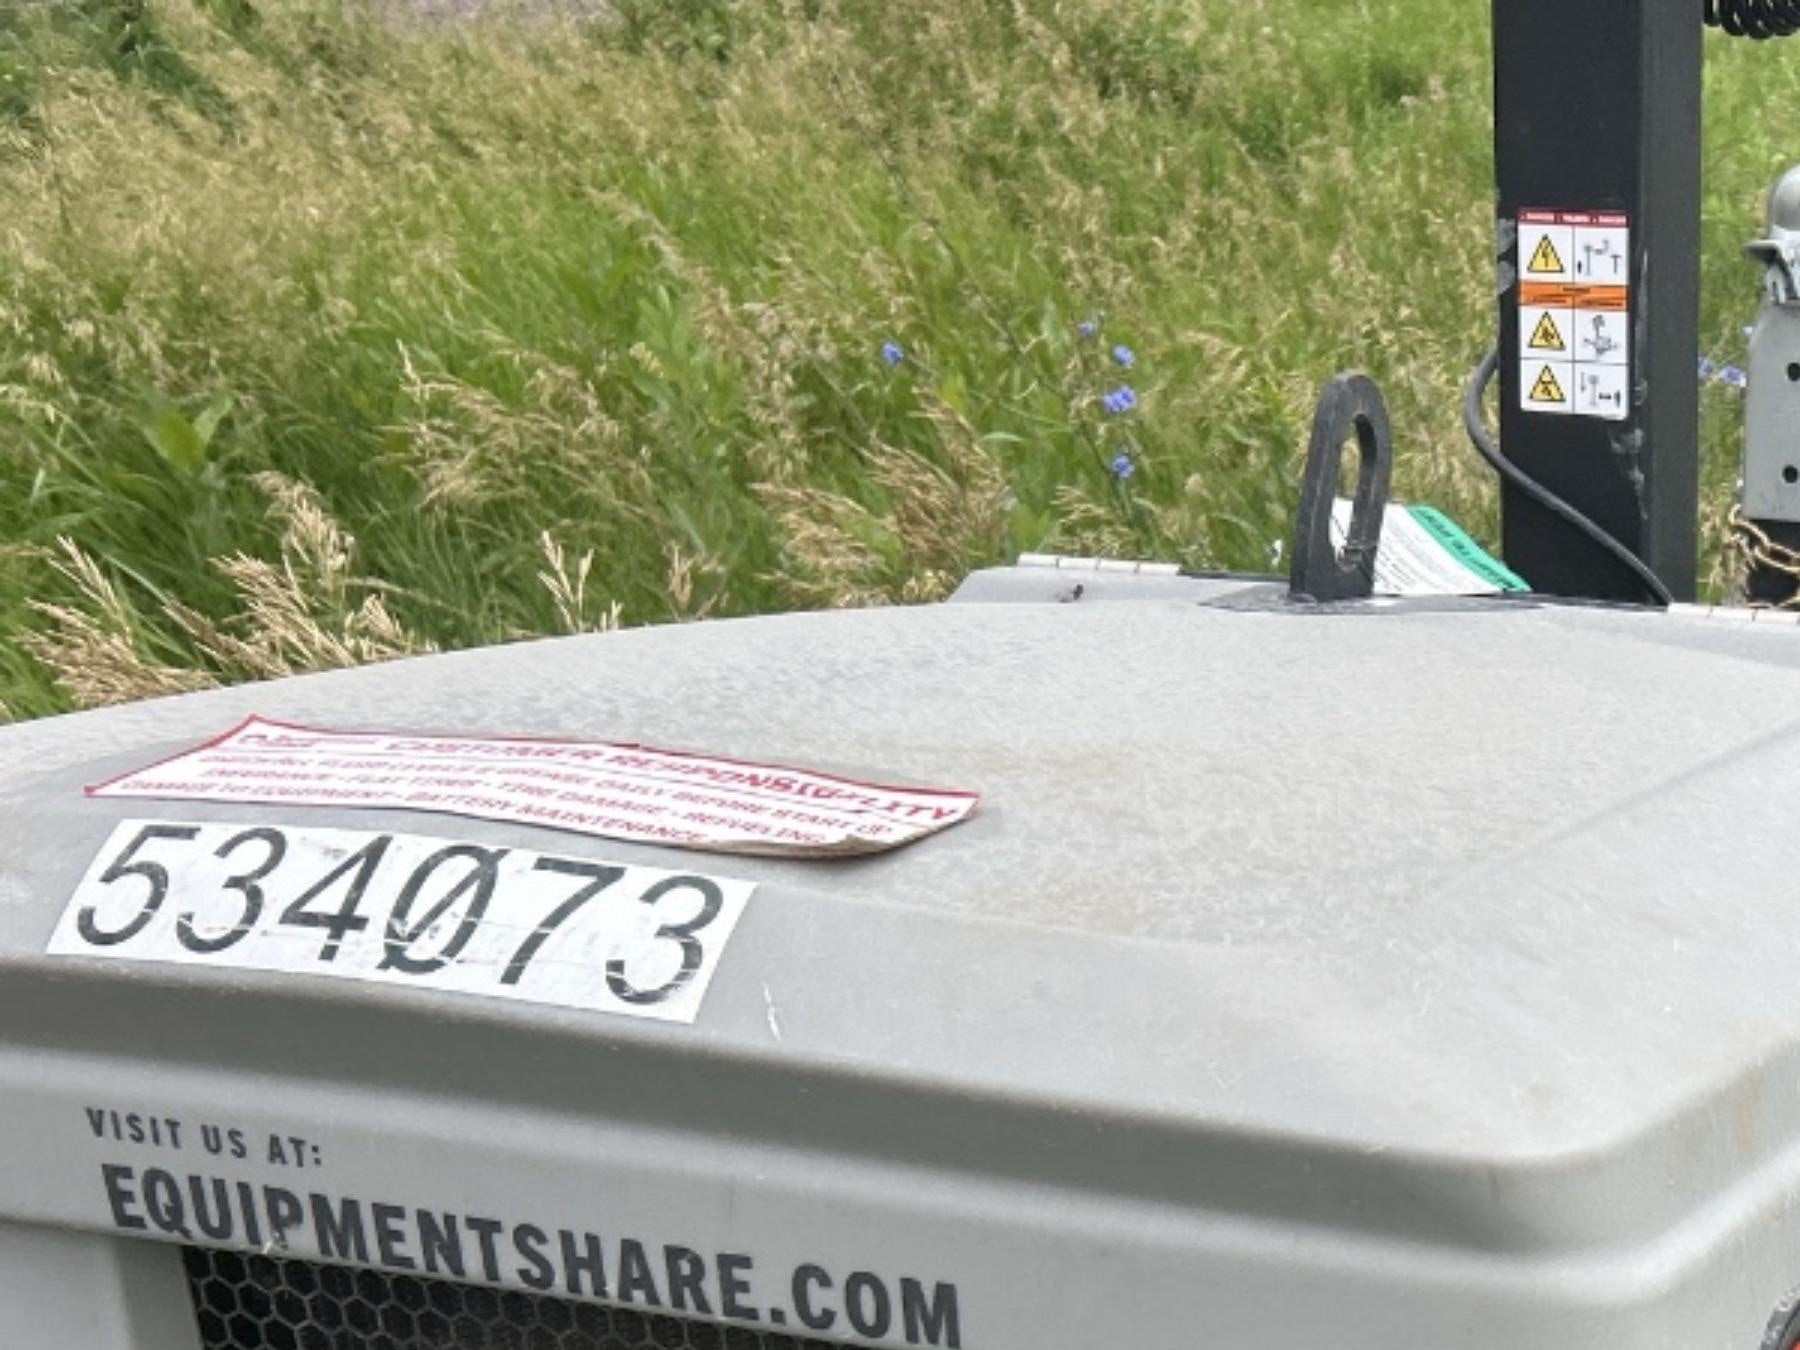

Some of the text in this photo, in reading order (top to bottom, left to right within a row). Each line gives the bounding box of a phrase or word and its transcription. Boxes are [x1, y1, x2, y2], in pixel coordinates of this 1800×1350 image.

[74, 822, 727, 1005] 534073
[86, 1106, 323, 1168] VISIT US AT:
[101, 1162, 962, 1350] EQUIPMENTSHARE.COM
